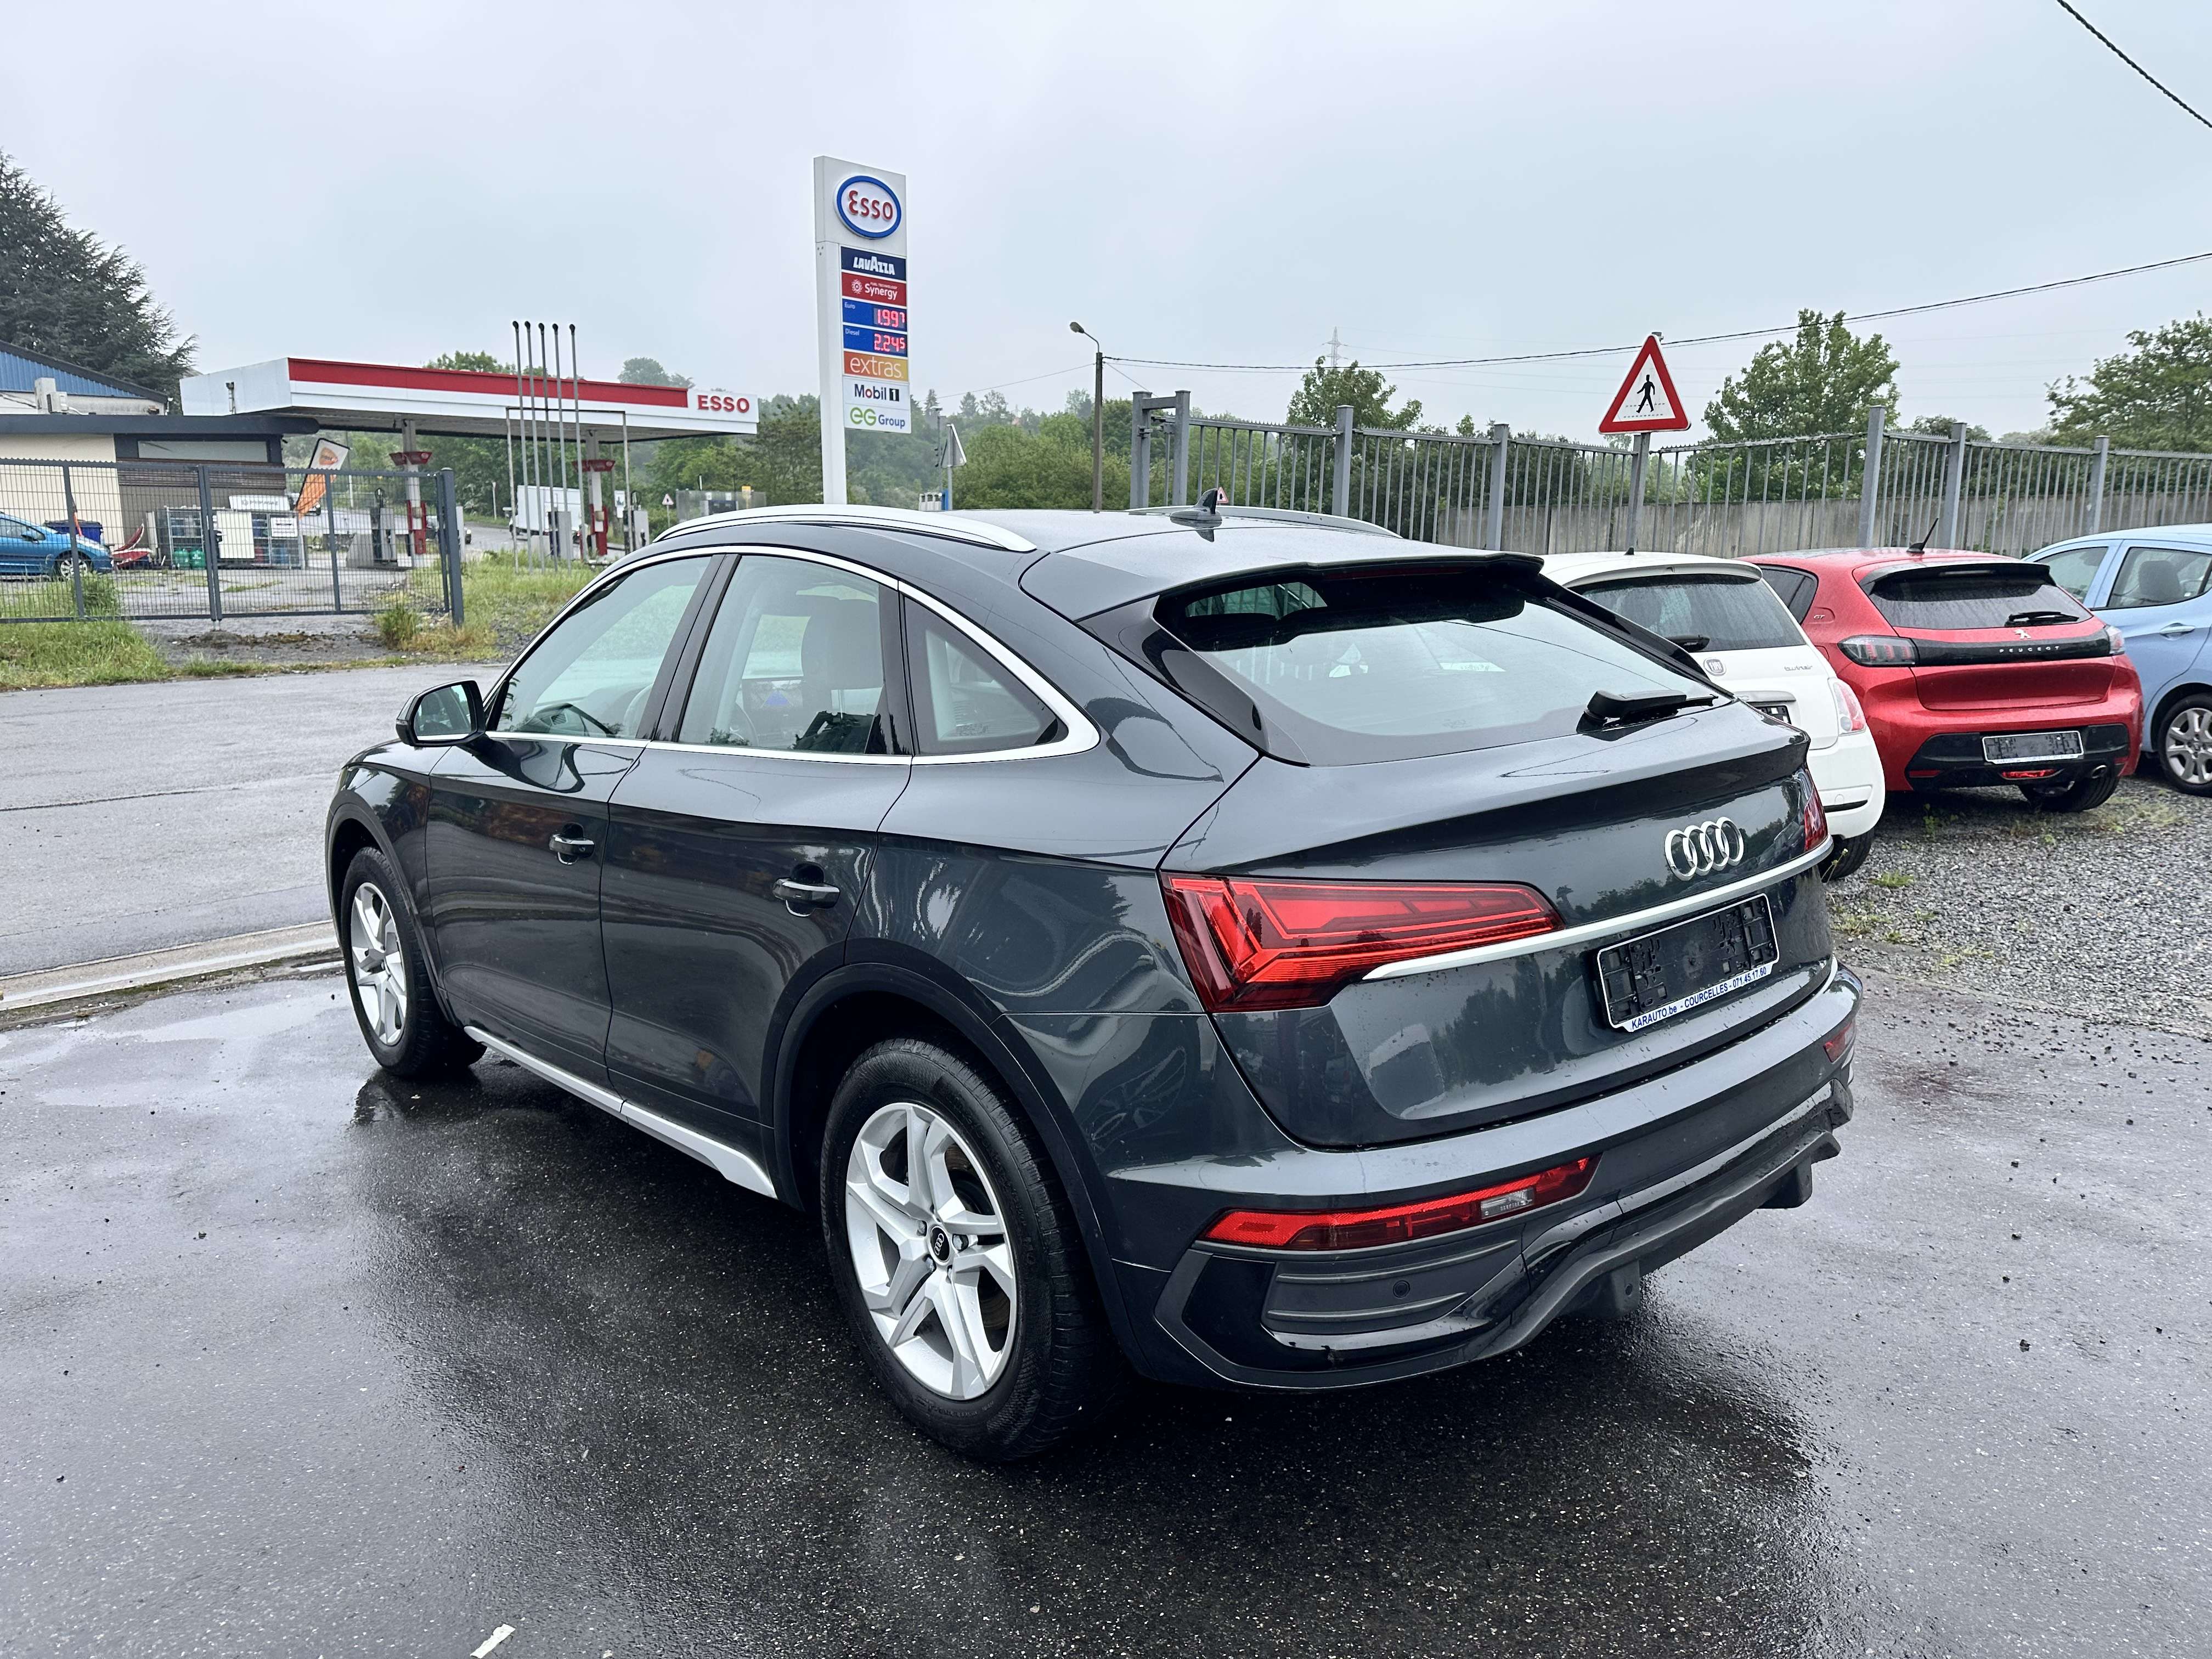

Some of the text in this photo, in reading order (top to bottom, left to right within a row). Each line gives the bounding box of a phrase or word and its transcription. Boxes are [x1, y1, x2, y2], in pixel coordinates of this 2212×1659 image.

[853, 256, 895, 275] LAVAZZA
[864, 283, 898, 300] Synergy
[874, 333, 905, 352] 2.245
[850, 357, 902, 379] extras
[855, 383, 887, 400] Mobil
[697, 394, 749, 413] ESSO
[878, 415, 905, 429] Group
[1632, 1006, 1677, 1029] KARAUTO.be
[1684, 983, 1728, 1008] COURCELLES
